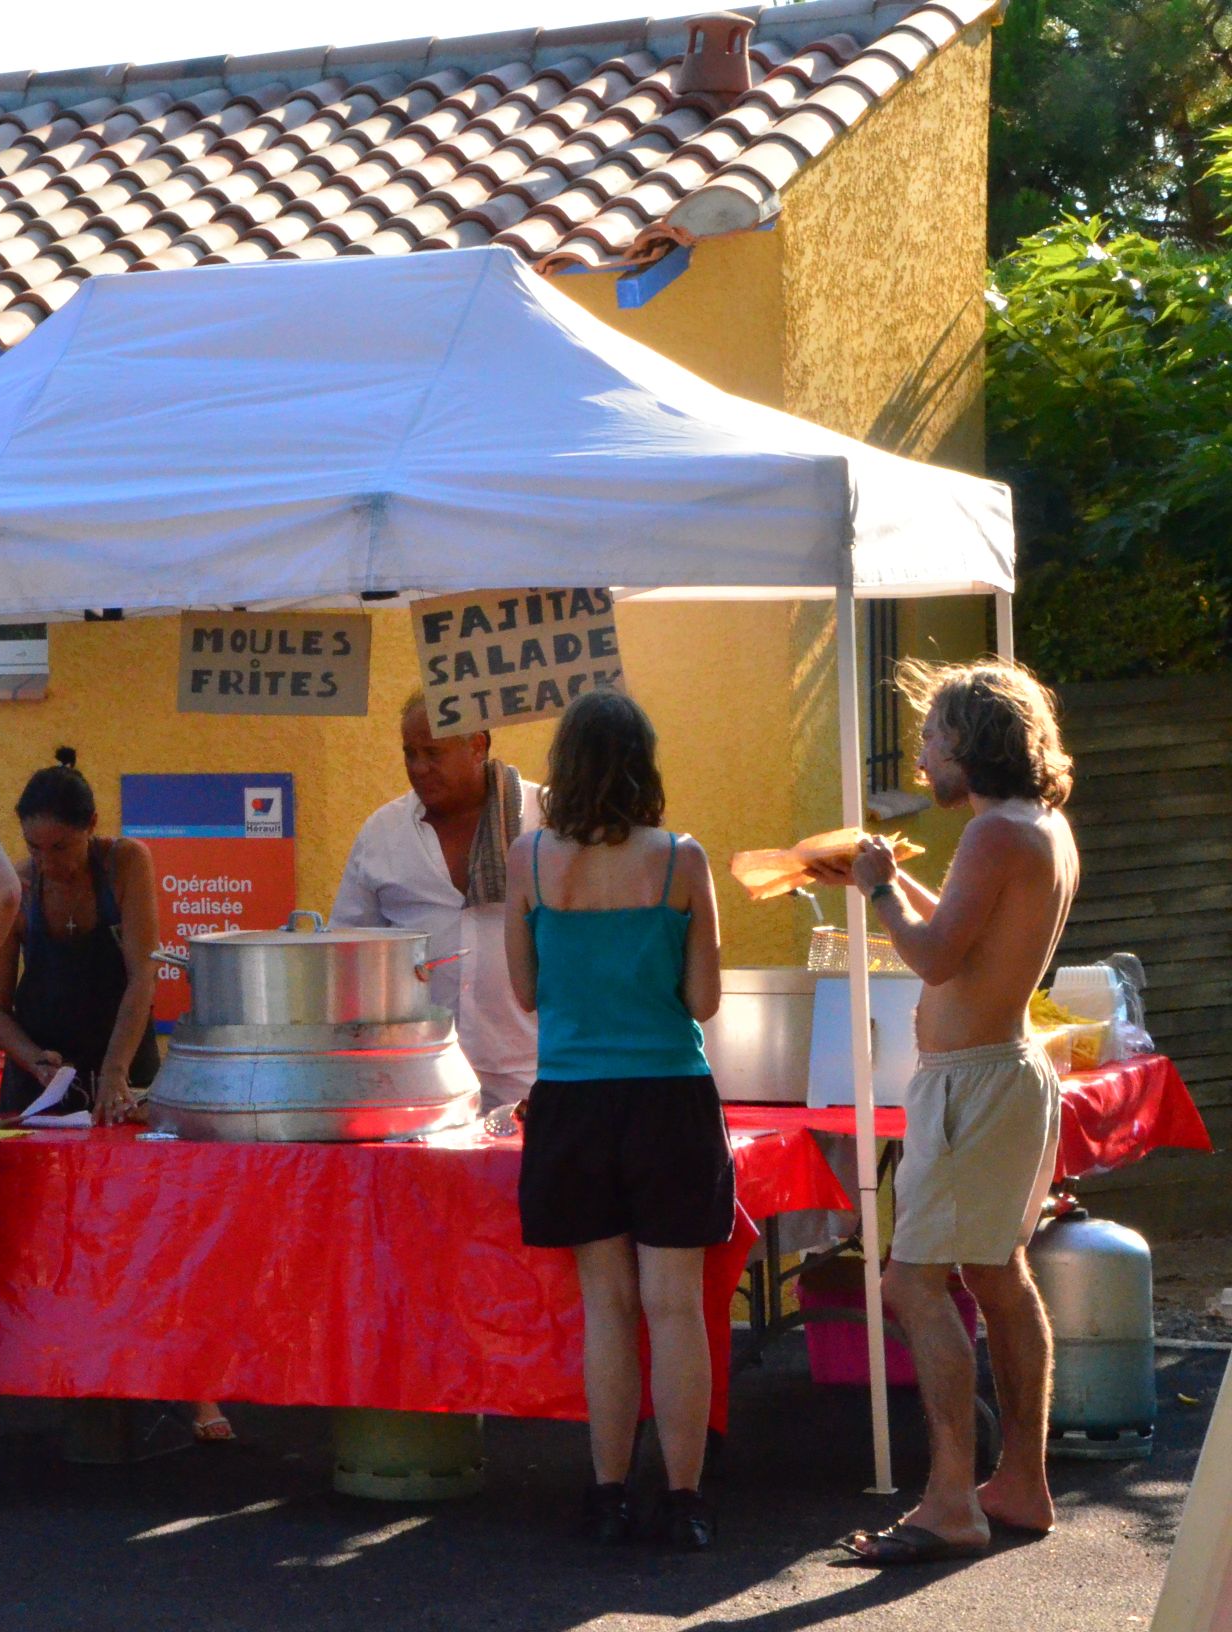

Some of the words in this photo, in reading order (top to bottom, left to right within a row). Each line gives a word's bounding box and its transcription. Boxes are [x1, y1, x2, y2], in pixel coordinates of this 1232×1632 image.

[422, 587, 614, 644] FAJITAS
[191, 628, 352, 657] MOULES
[428, 626, 618, 687] SALADE
[162, 875, 252, 895] Opération
[172, 896, 243, 914] réalisée
[176, 922, 219, 937] avec
[224, 918, 241, 934] le
[157, 962, 181, 980] de
